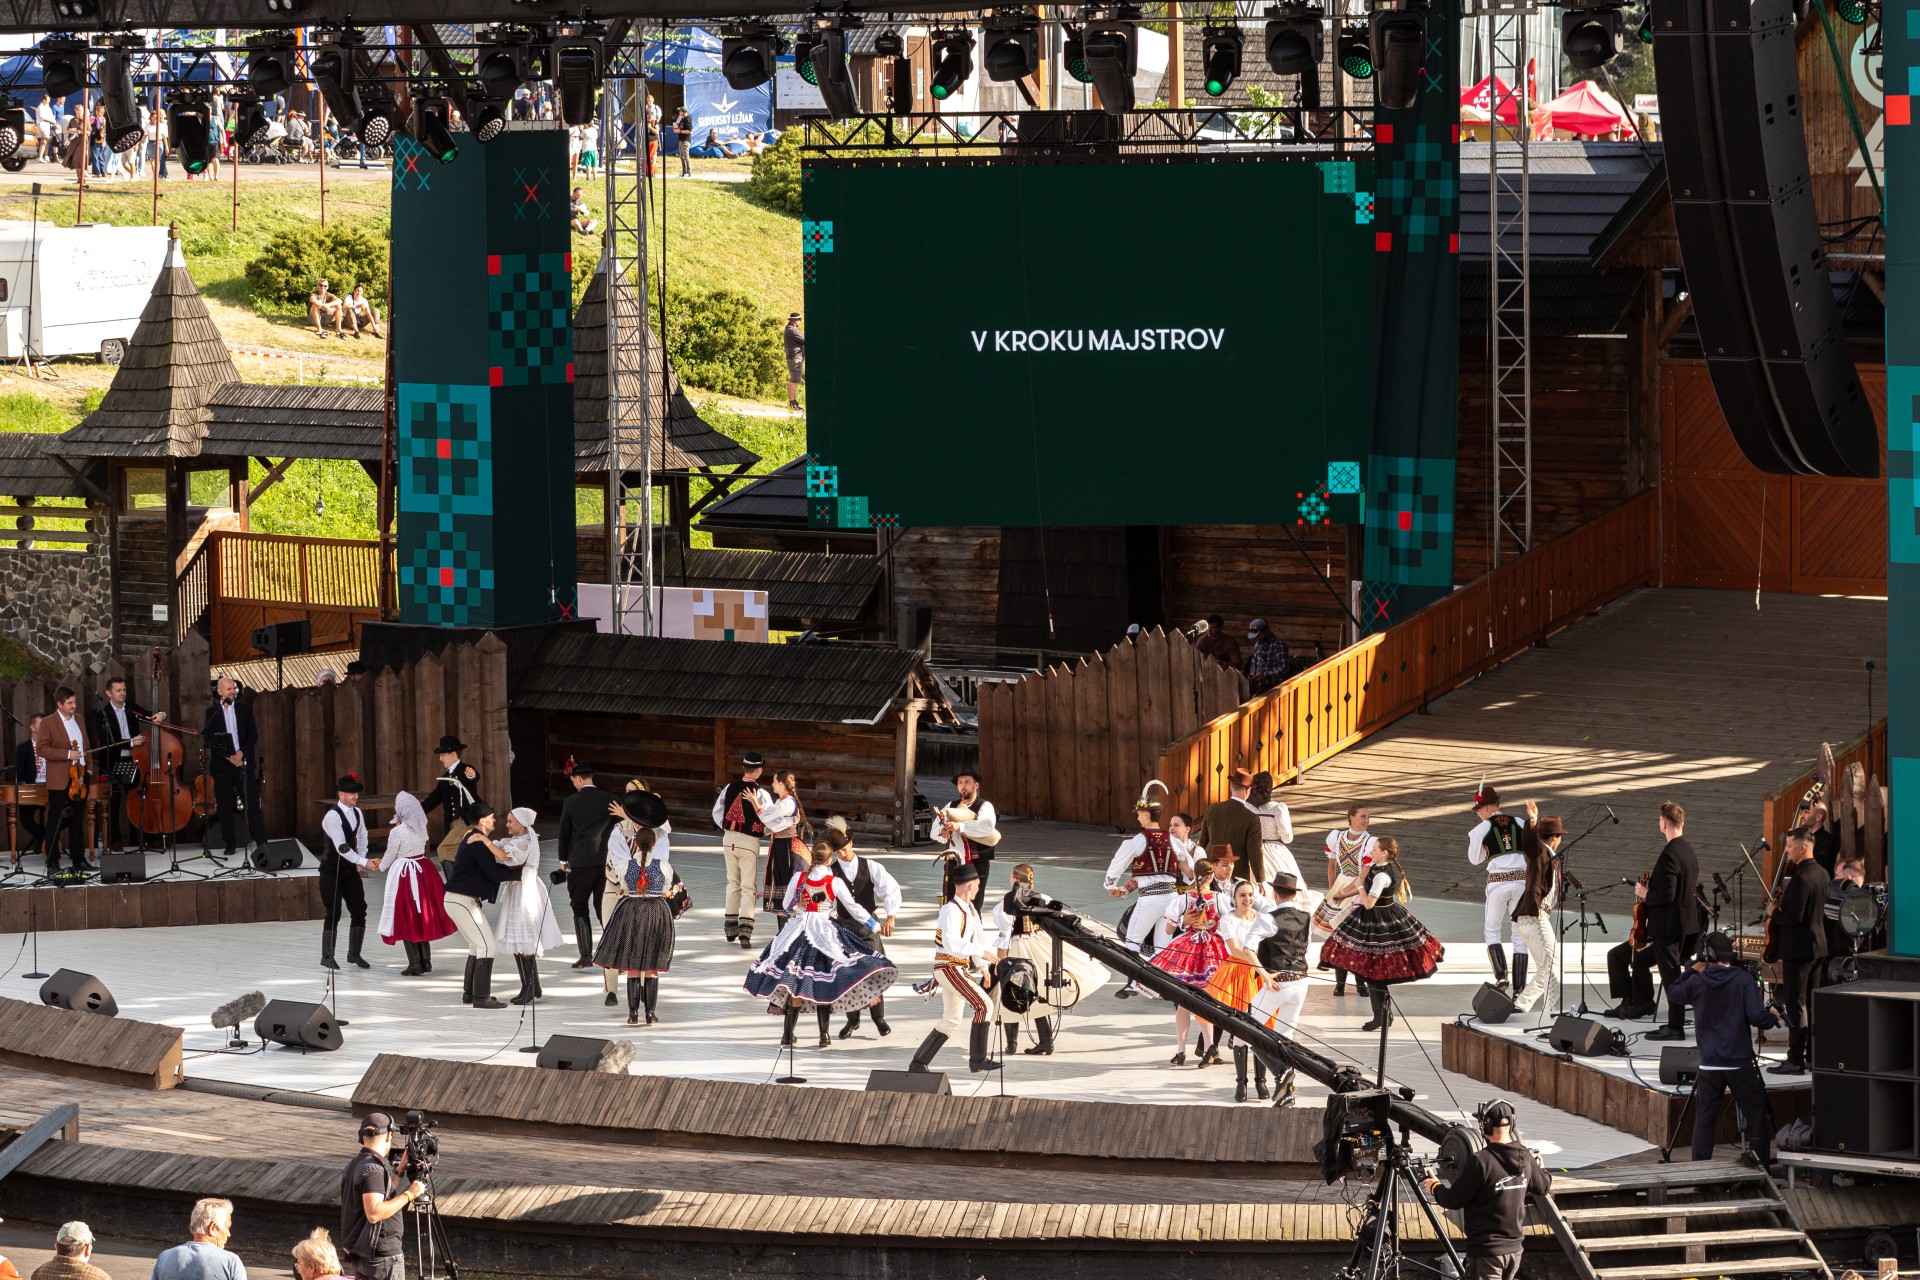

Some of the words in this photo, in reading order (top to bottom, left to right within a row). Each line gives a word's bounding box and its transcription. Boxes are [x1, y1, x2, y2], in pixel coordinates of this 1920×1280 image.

[732, 111, 754, 124] LEŽIAK
[970, 330, 988, 352] V
[994, 329, 1083, 351] KROKU
[1088, 328, 1225, 350] MAJSTROV
